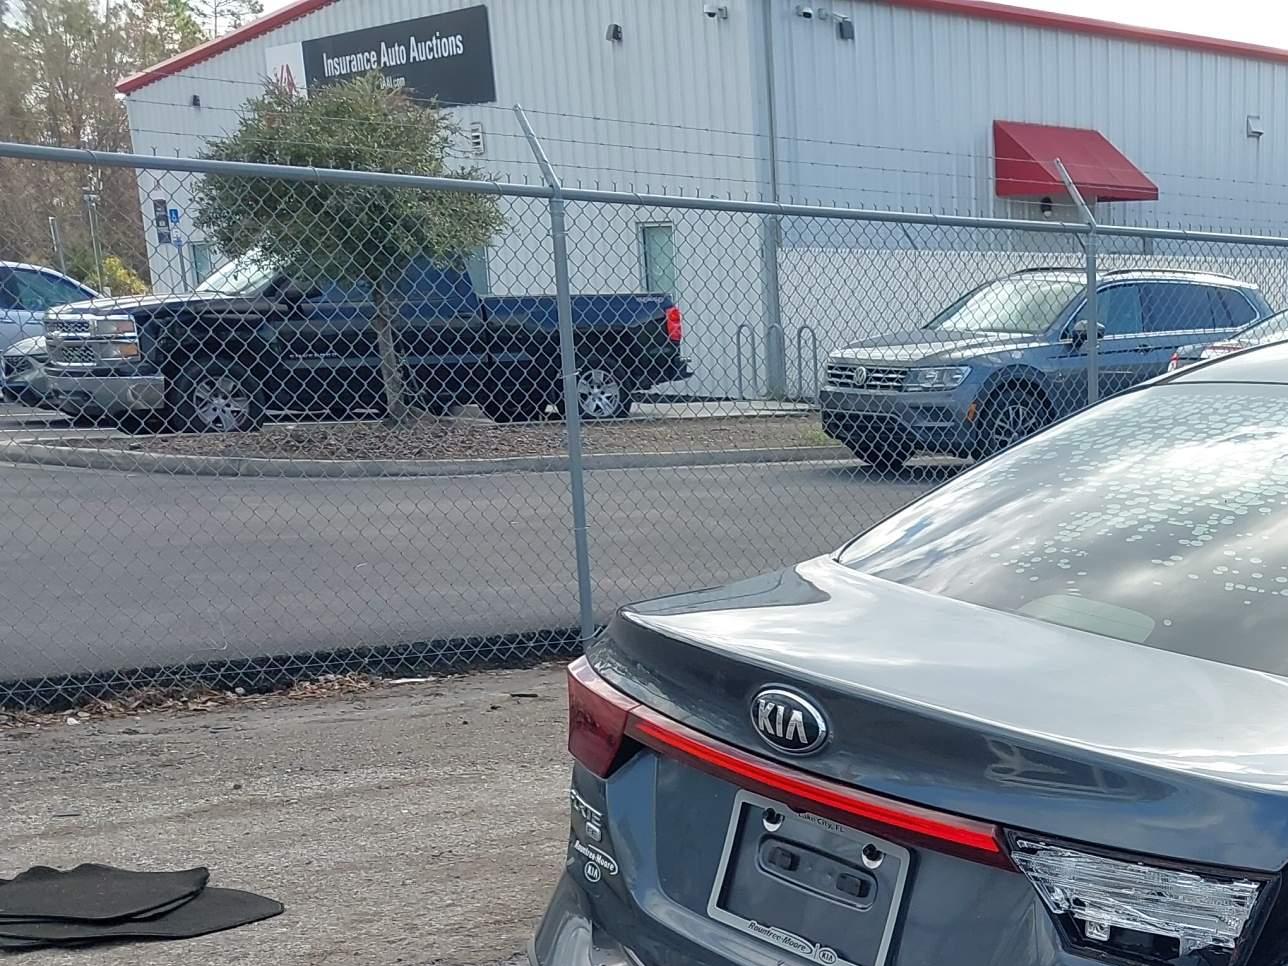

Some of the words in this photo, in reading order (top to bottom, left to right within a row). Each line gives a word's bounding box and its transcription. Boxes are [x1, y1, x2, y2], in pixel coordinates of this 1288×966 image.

[323, 50, 378, 78] Insurance
[380, 41, 407, 68] Auto
[409, 31, 464, 63] Auctions
[757, 698, 809, 744] KIA
[835, 824, 845, 833] FL
[574, 839, 615, 871] Rountree-Moore
[748, 921, 807, 953] Rountree-Moore
